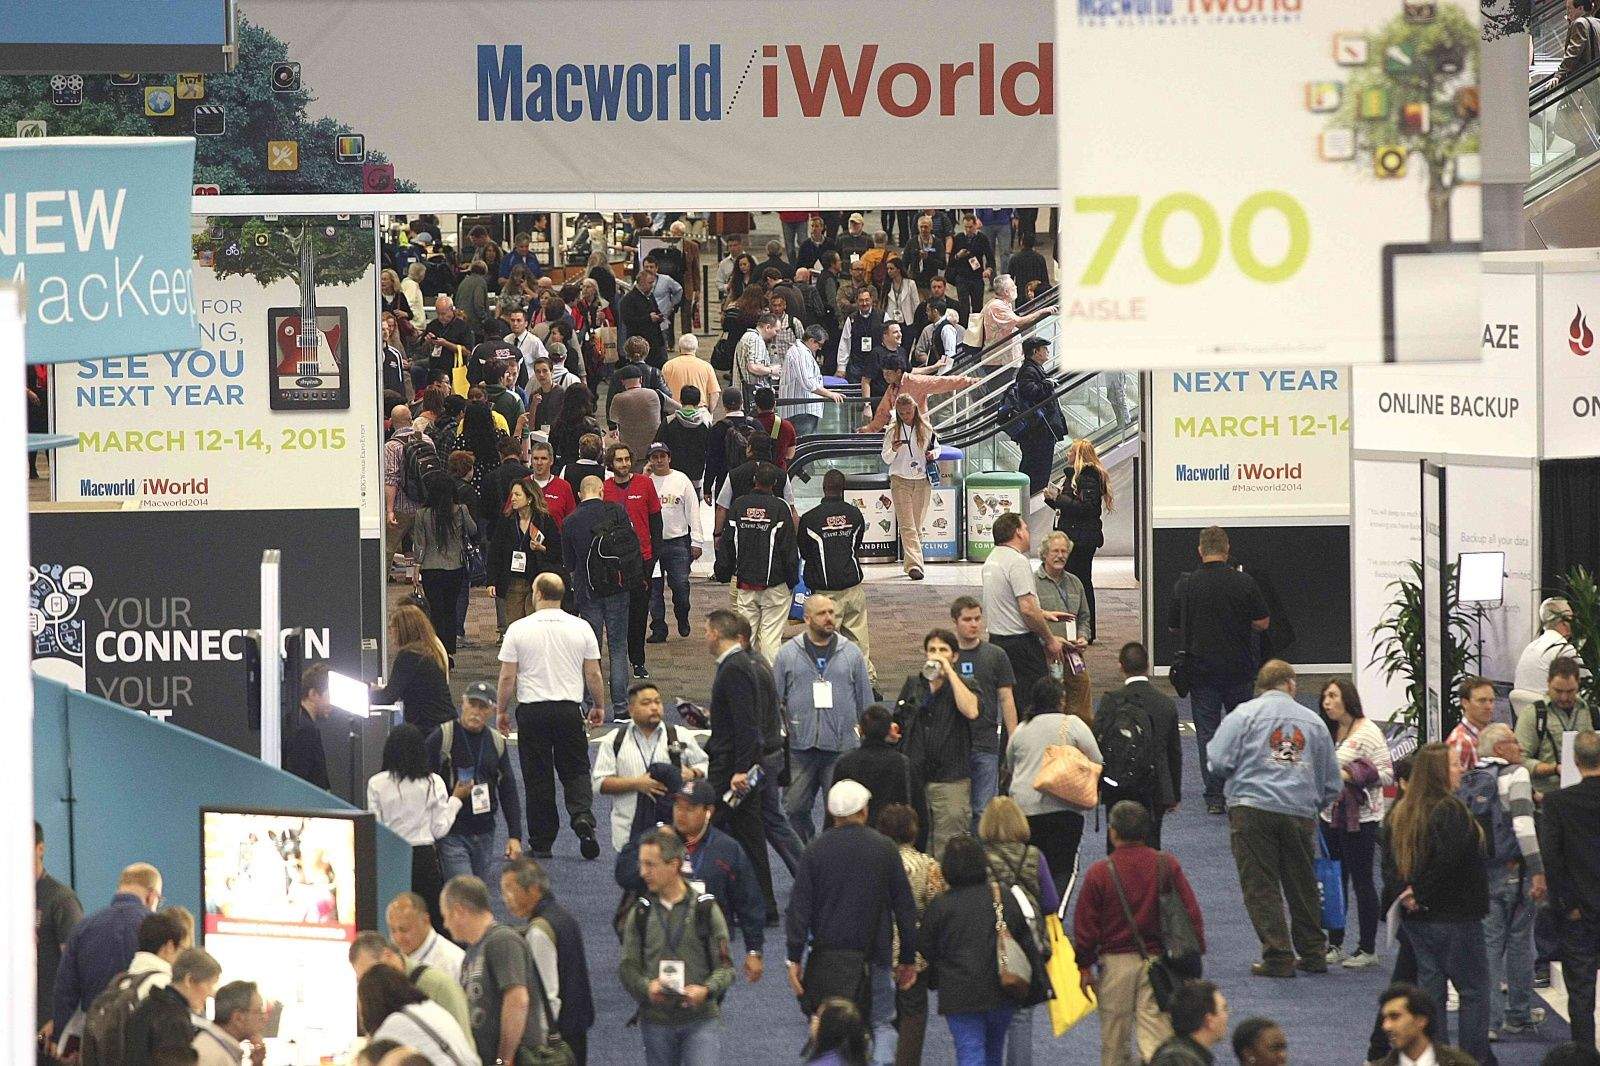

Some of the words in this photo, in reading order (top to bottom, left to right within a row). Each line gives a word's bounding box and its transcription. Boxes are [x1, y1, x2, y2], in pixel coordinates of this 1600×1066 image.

[476, 43, 721, 122] Macworld
[761, 42, 1055, 118] iWorld
[1074, 190, 1311, 287] 700
[202, 299, 242, 314] FOR
[1067, 298, 1147, 322] AISLE
[77, 355, 149, 379] SEE
[164, 349, 244, 379] YOU
[1173, 371, 1250, 393] NEXT
[1259, 370, 1338, 391] YEAR
[77, 385, 156, 407] NEXT
[164, 384, 245, 406] YEAR
[1378, 392, 1444, 415] ONLINE
[1450, 394, 1519, 418] BACKUP
[1174, 415, 1279, 438] MARCH
[78, 430, 184, 452] MARCH
[194, 428, 272, 454] 12-14,
[281, 428, 346, 450] 2015
[1176, 464, 1229, 481] Macworld
[1237, 463, 1302, 480] iWorld
[80, 478, 135, 496] Macworld
[143, 477, 209, 495] iWorld
[1232, 483, 1302, 492] #Macworld2014
[1461, 531, 1487, 544] Backup
[1498, 535, 1513, 547] your
[94, 597, 192, 629] YOUR
[96, 676, 194, 708] YOUR
